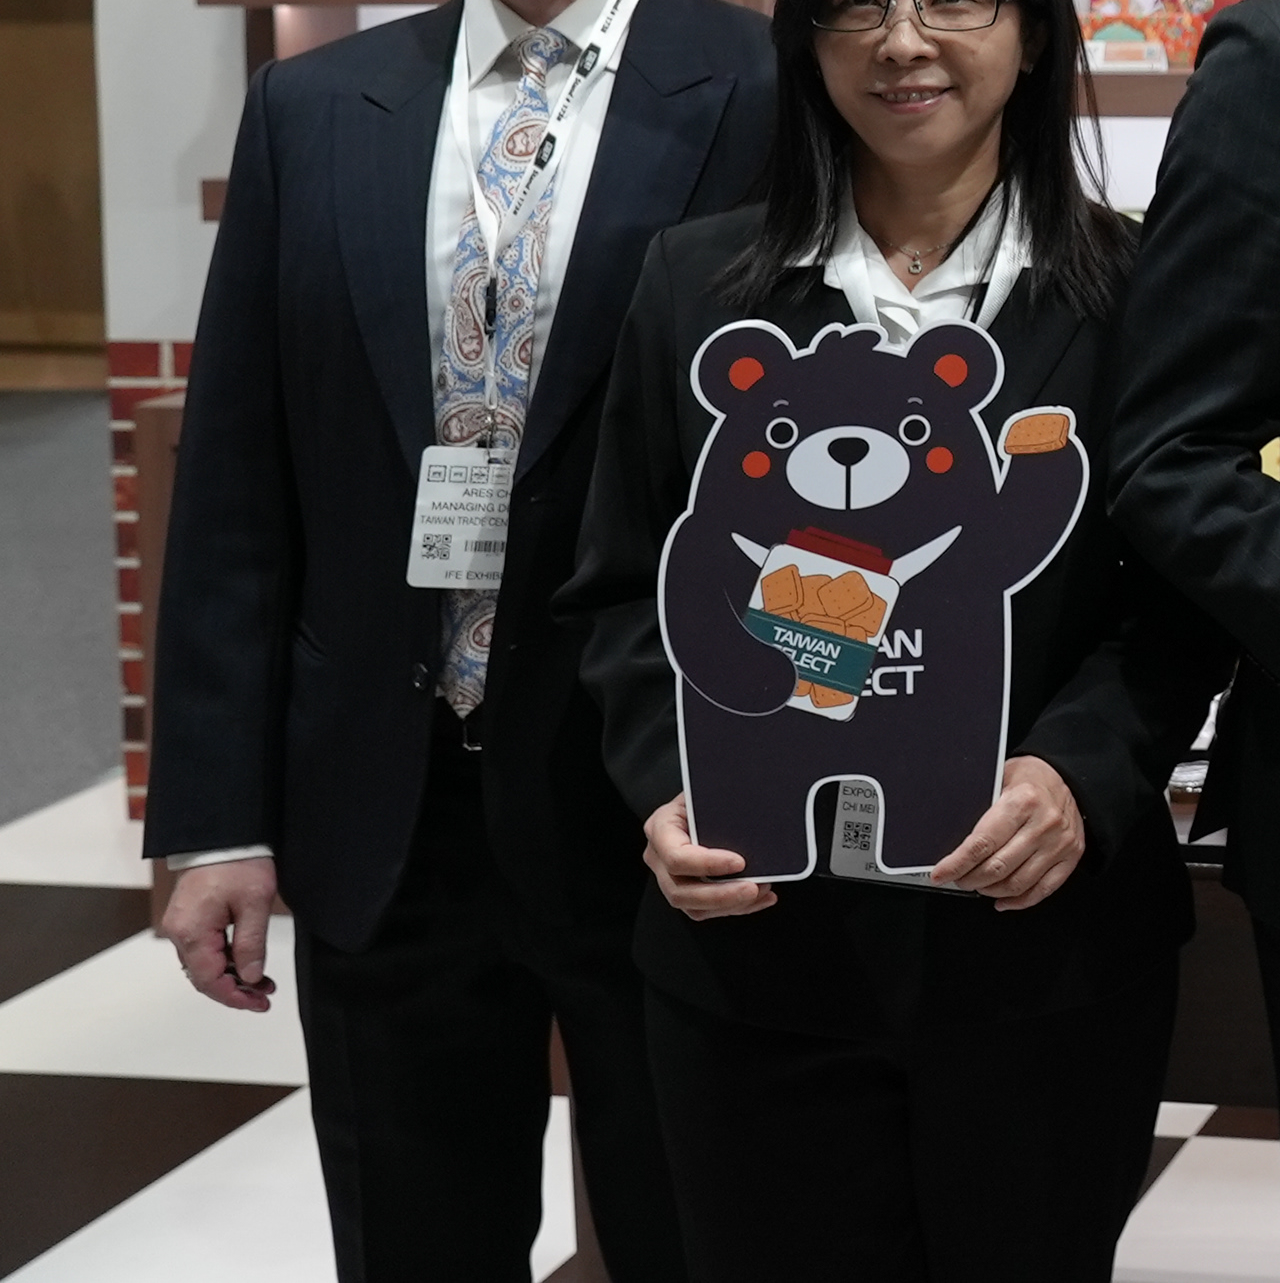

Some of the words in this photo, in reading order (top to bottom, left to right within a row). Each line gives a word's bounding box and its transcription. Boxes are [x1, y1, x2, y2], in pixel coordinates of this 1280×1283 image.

[567, 76, 581, 97] Stand
[524, 169, 538, 190] Stand
[462, 488, 494, 498] ARES
[431, 502, 494, 513] MANAGING
[420, 515, 455, 526] TAIWAN
[458, 516, 486, 527] TRADE
[445, 571, 462, 580] IFE
[773, 626, 841, 659] TAIWAN
[843, 802, 857, 811] CHI
[860, 804, 875, 813] MEI
